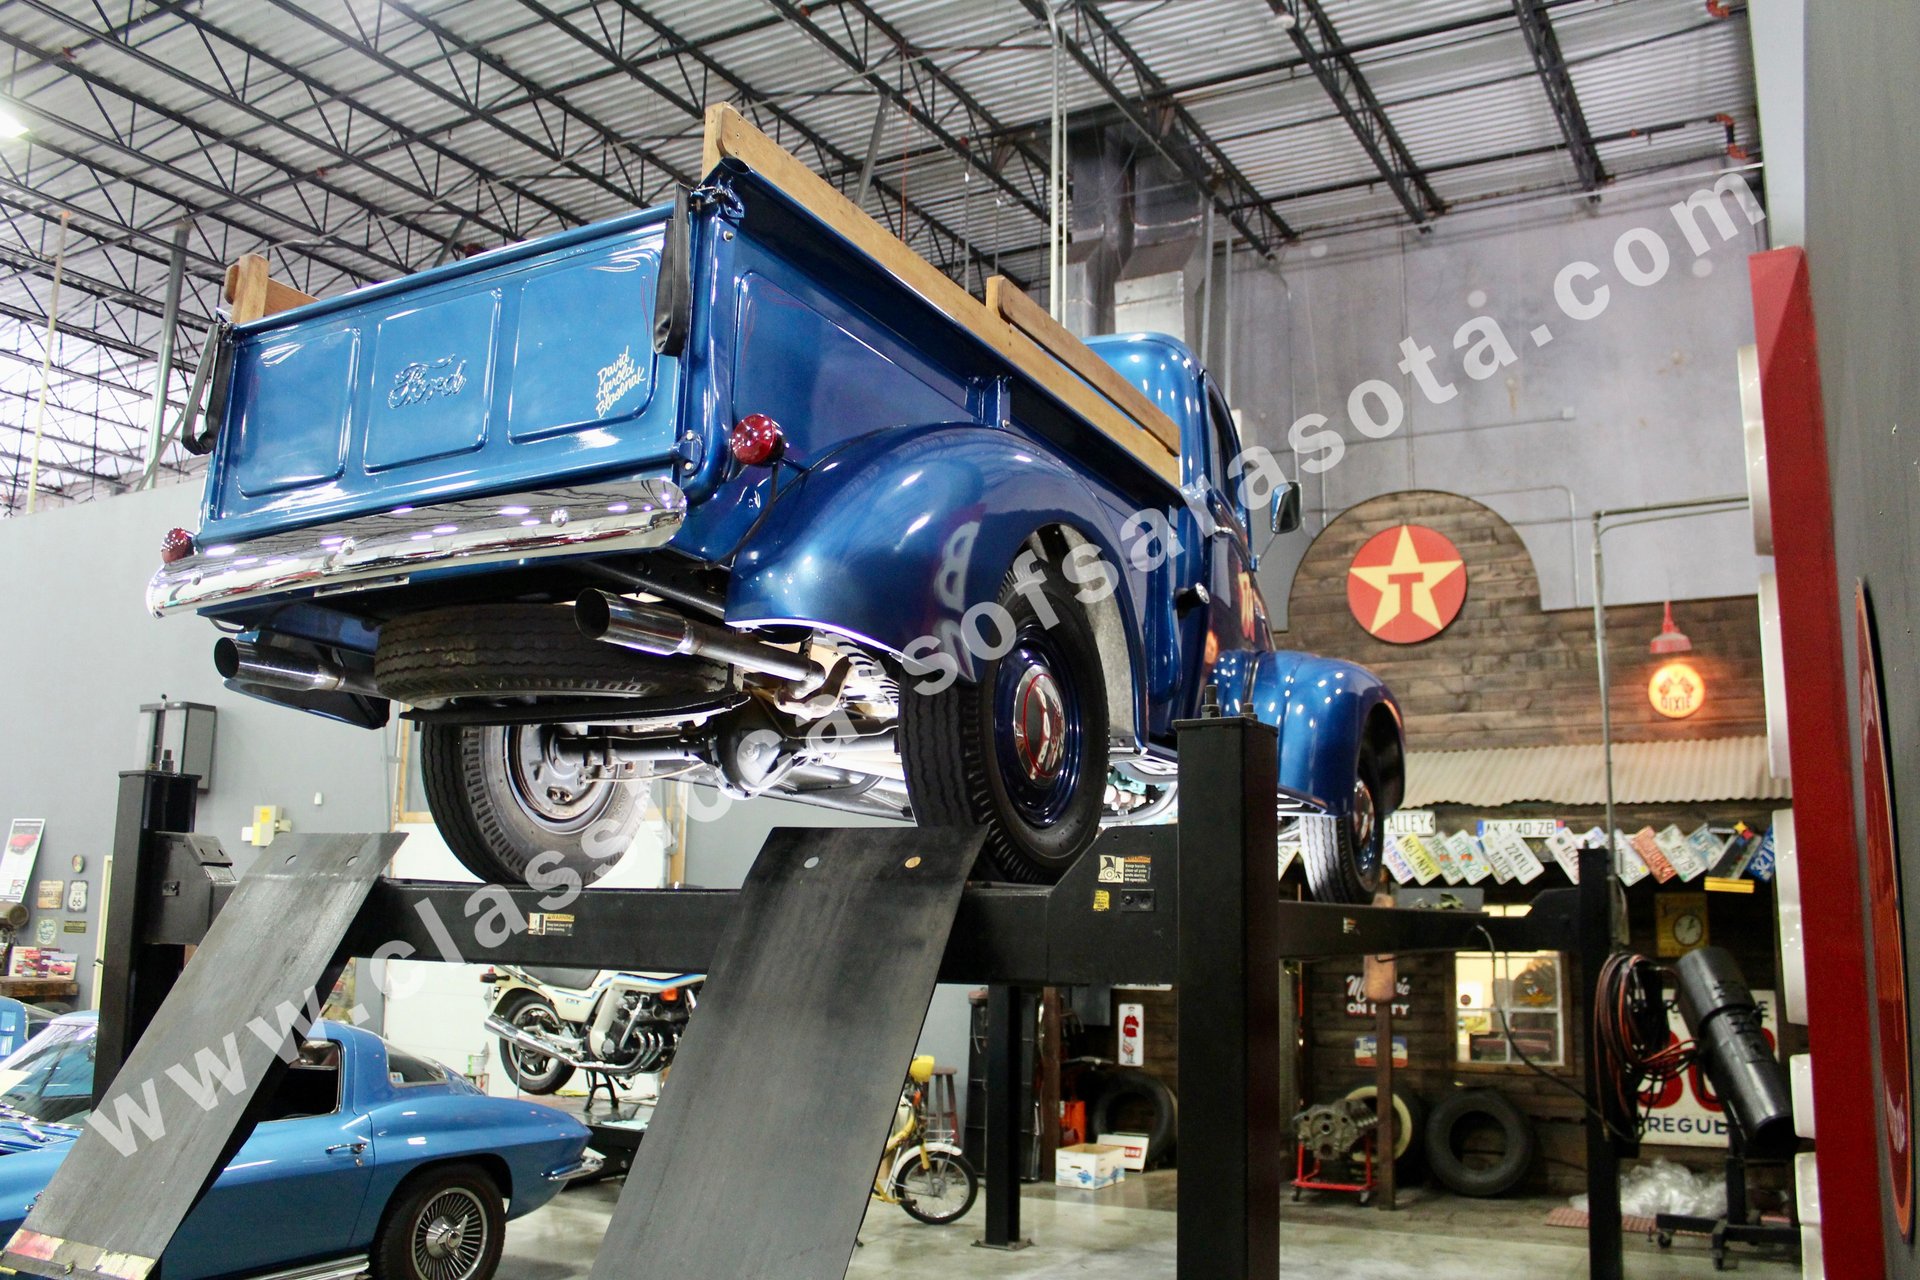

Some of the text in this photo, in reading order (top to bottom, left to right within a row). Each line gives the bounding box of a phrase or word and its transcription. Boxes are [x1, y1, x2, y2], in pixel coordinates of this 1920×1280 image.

[388, 353, 466, 409] Ford
[596, 359, 635, 401] Harold
[597, 345, 629, 386] David
[1660, 696, 1691, 712] DIXIE
[1347, 1003, 1367, 1014] ON
